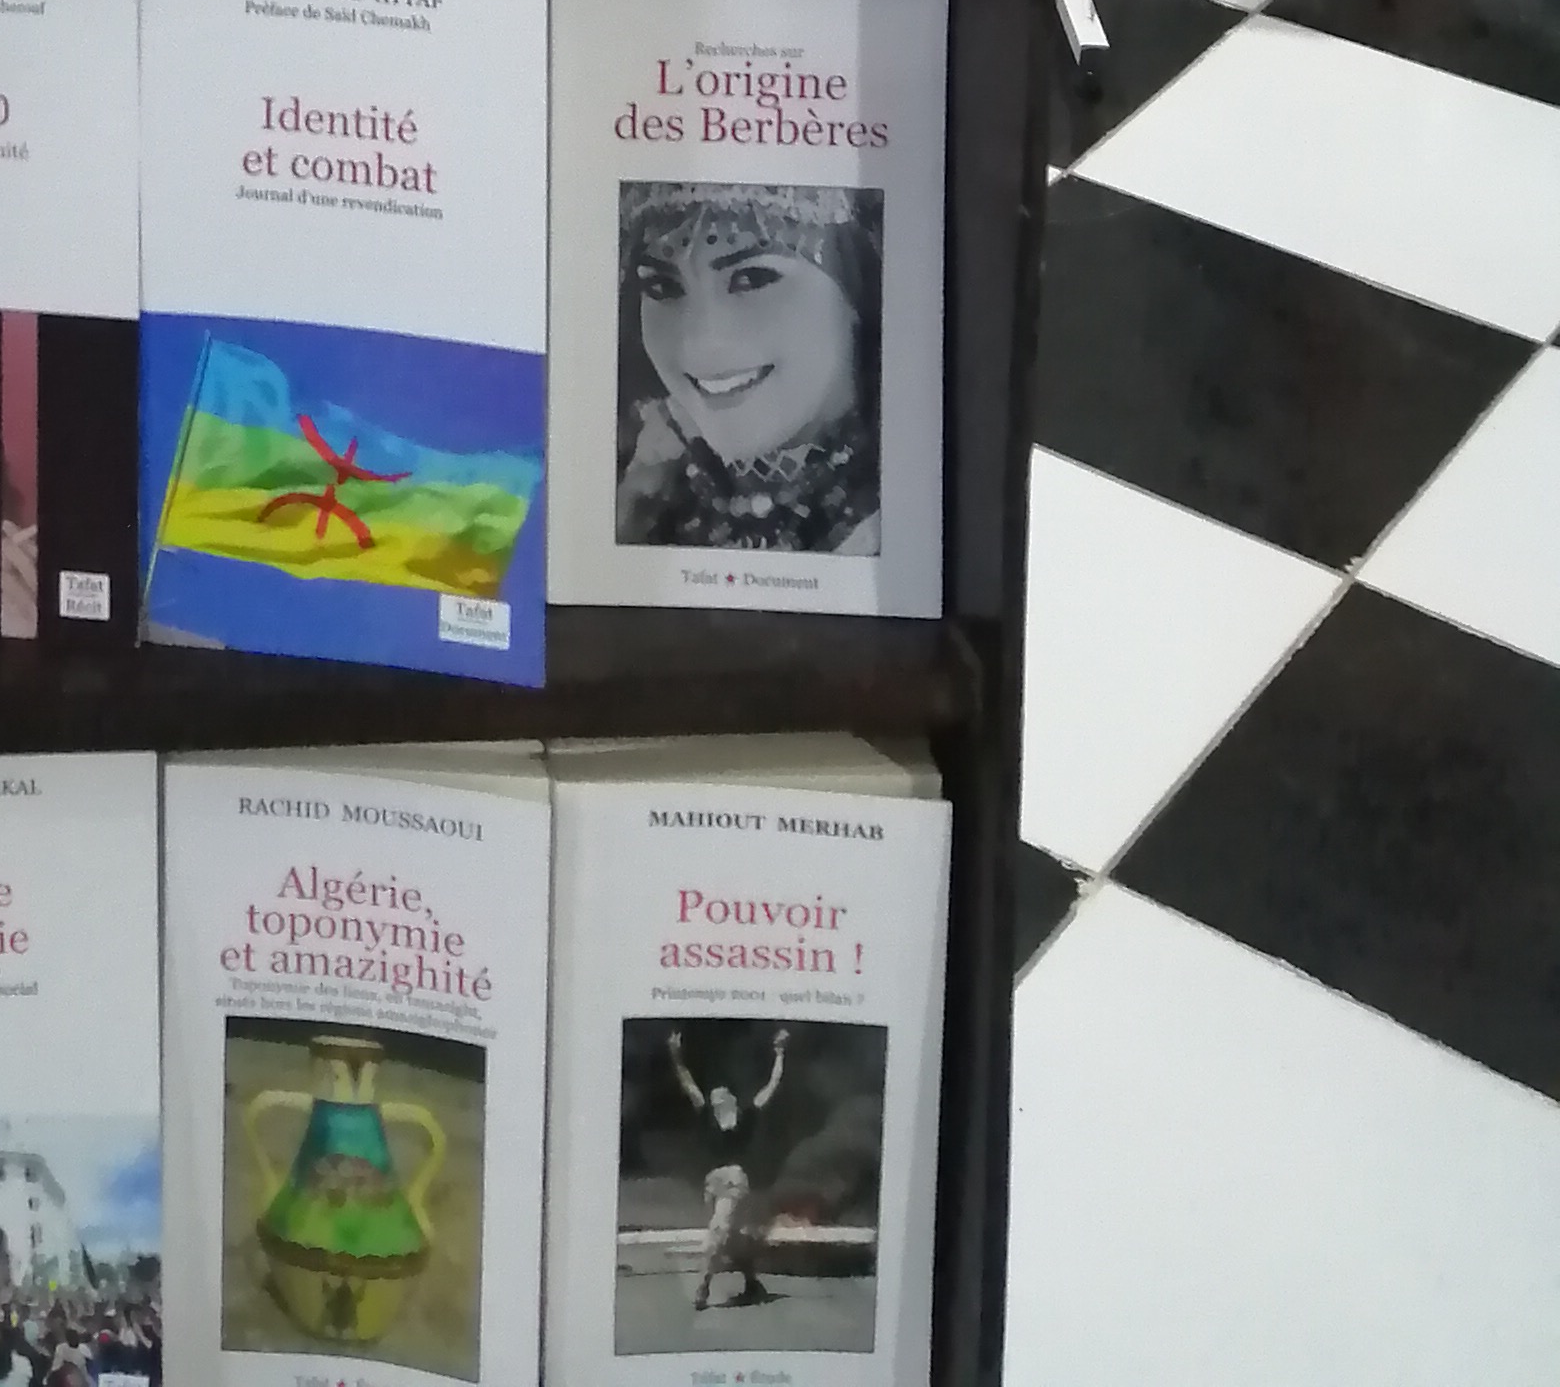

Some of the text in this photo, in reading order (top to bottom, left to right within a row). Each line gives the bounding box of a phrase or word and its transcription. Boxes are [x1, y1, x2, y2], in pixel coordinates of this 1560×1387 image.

[656, 58, 848, 109] L'origine
[261, 95, 418, 144] Identité
[614, 102, 889, 149] des Berbères
[242, 146, 437, 194] et combat
[236, 185, 293, 203] Journal
[342, 196, 444, 220] revendication
[238, 797, 484, 842] RACHID MOUSSAOUI
[277, 865, 432, 921] Algérie,
[676, 889, 847, 930] Pouvoir
[246, 904, 465, 958] toponymie
[219, 942, 256, 973] et
[270, 949, 492, 1002] amazighité
[659, 938, 864, 975] assassin !
